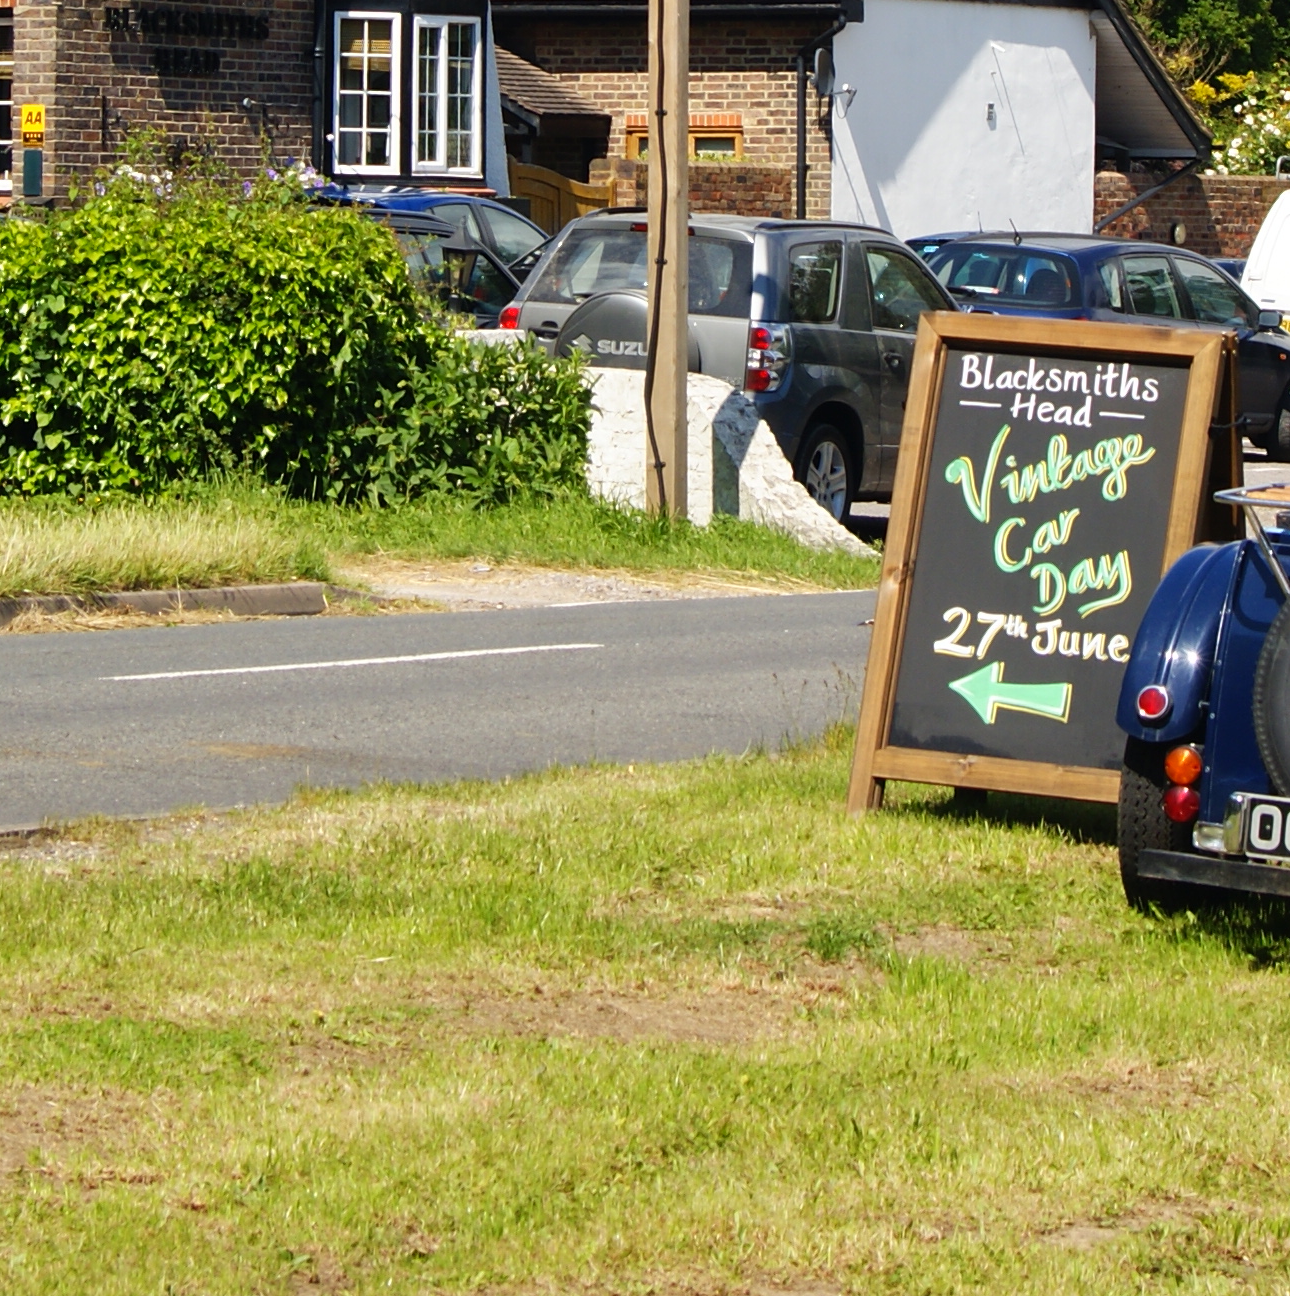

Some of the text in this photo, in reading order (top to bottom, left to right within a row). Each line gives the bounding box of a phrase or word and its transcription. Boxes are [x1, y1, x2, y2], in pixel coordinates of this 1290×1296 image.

[25, 111, 42, 125] AA
[959, 354, 1160, 403] Blacksmiths
[1010, 394, 1093, 428] Head
[944, 423, 1156, 524] Vintage
[993, 508, 1081, 573] Car
[1029, 549, 1133, 619] Day
[933, 606, 1131, 663] 27th June
